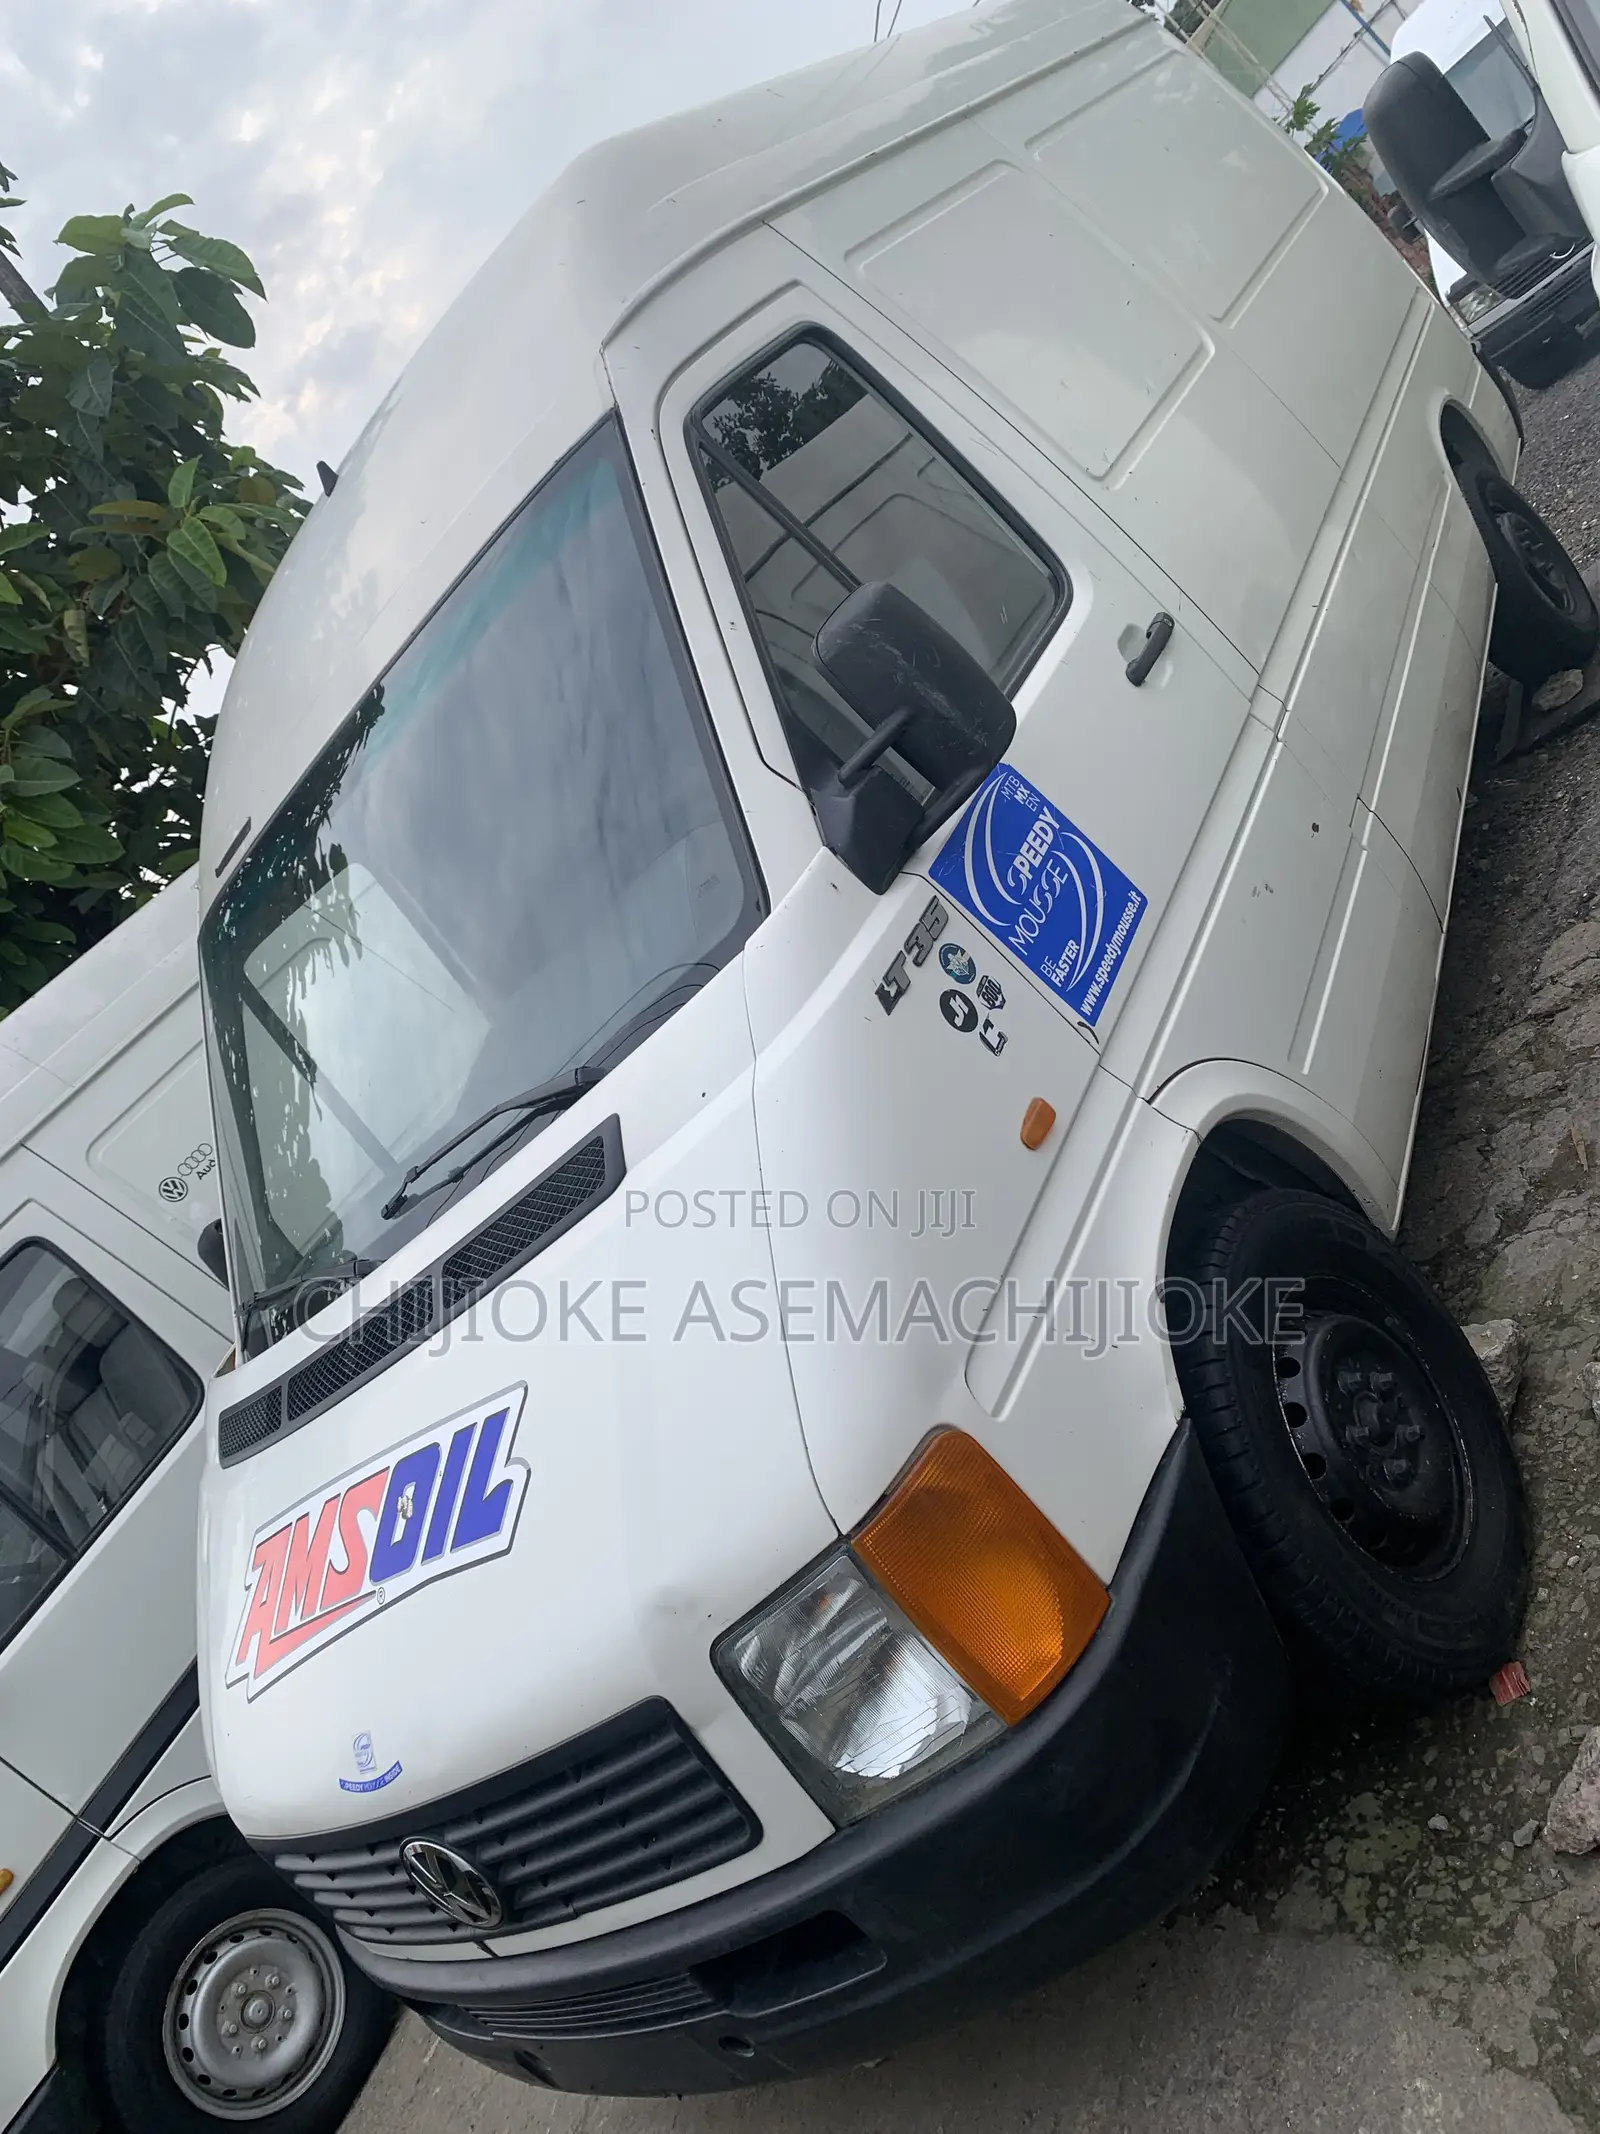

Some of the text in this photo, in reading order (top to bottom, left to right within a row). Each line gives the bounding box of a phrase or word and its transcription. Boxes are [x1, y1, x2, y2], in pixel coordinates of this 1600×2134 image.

[1001, 775, 1021, 801] MTB
[1013, 783, 1031, 805] MX
[1025, 792, 1041, 812] EN
[1007, 806, 1060, 895] SPEEDY
[1008, 858, 1069, 956] MOUSSE
[1040, 955, 1058, 978] BE
[1050, 939, 1081, 988] FASTER
[1080, 889, 1142, 1016] www.speedymousse.it
[236, 1407, 515, 1680] AMSOIL
